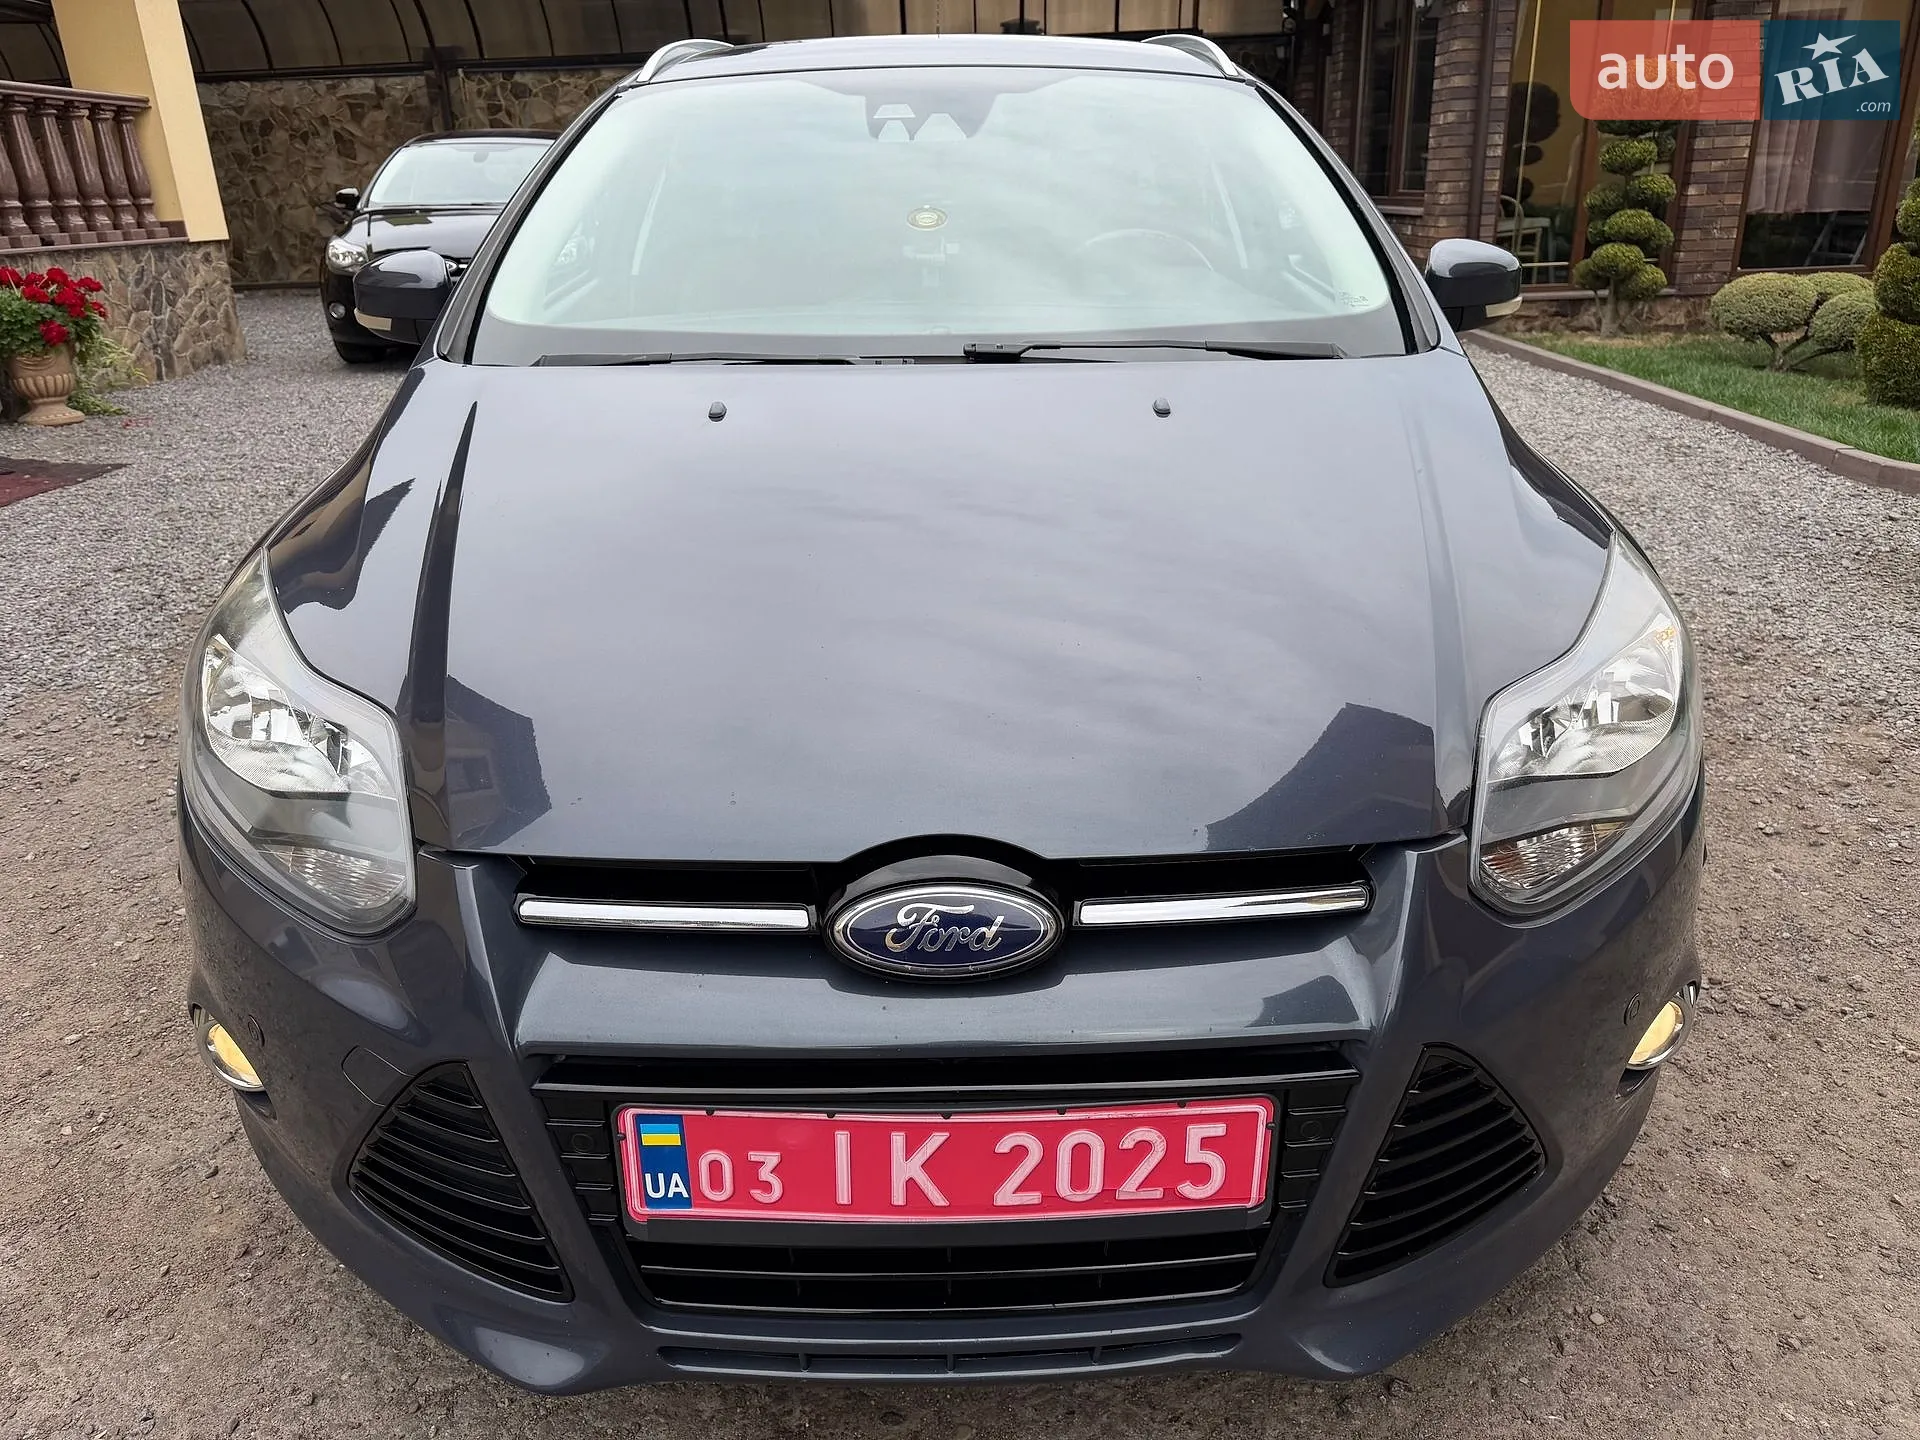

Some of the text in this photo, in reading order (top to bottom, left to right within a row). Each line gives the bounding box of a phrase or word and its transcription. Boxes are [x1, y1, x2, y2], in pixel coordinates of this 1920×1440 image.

[884, 902, 1003, 952] Ford
[645, 1173, 689, 1199] UA
[699, 1123, 1227, 1207] 03 IK 2025
